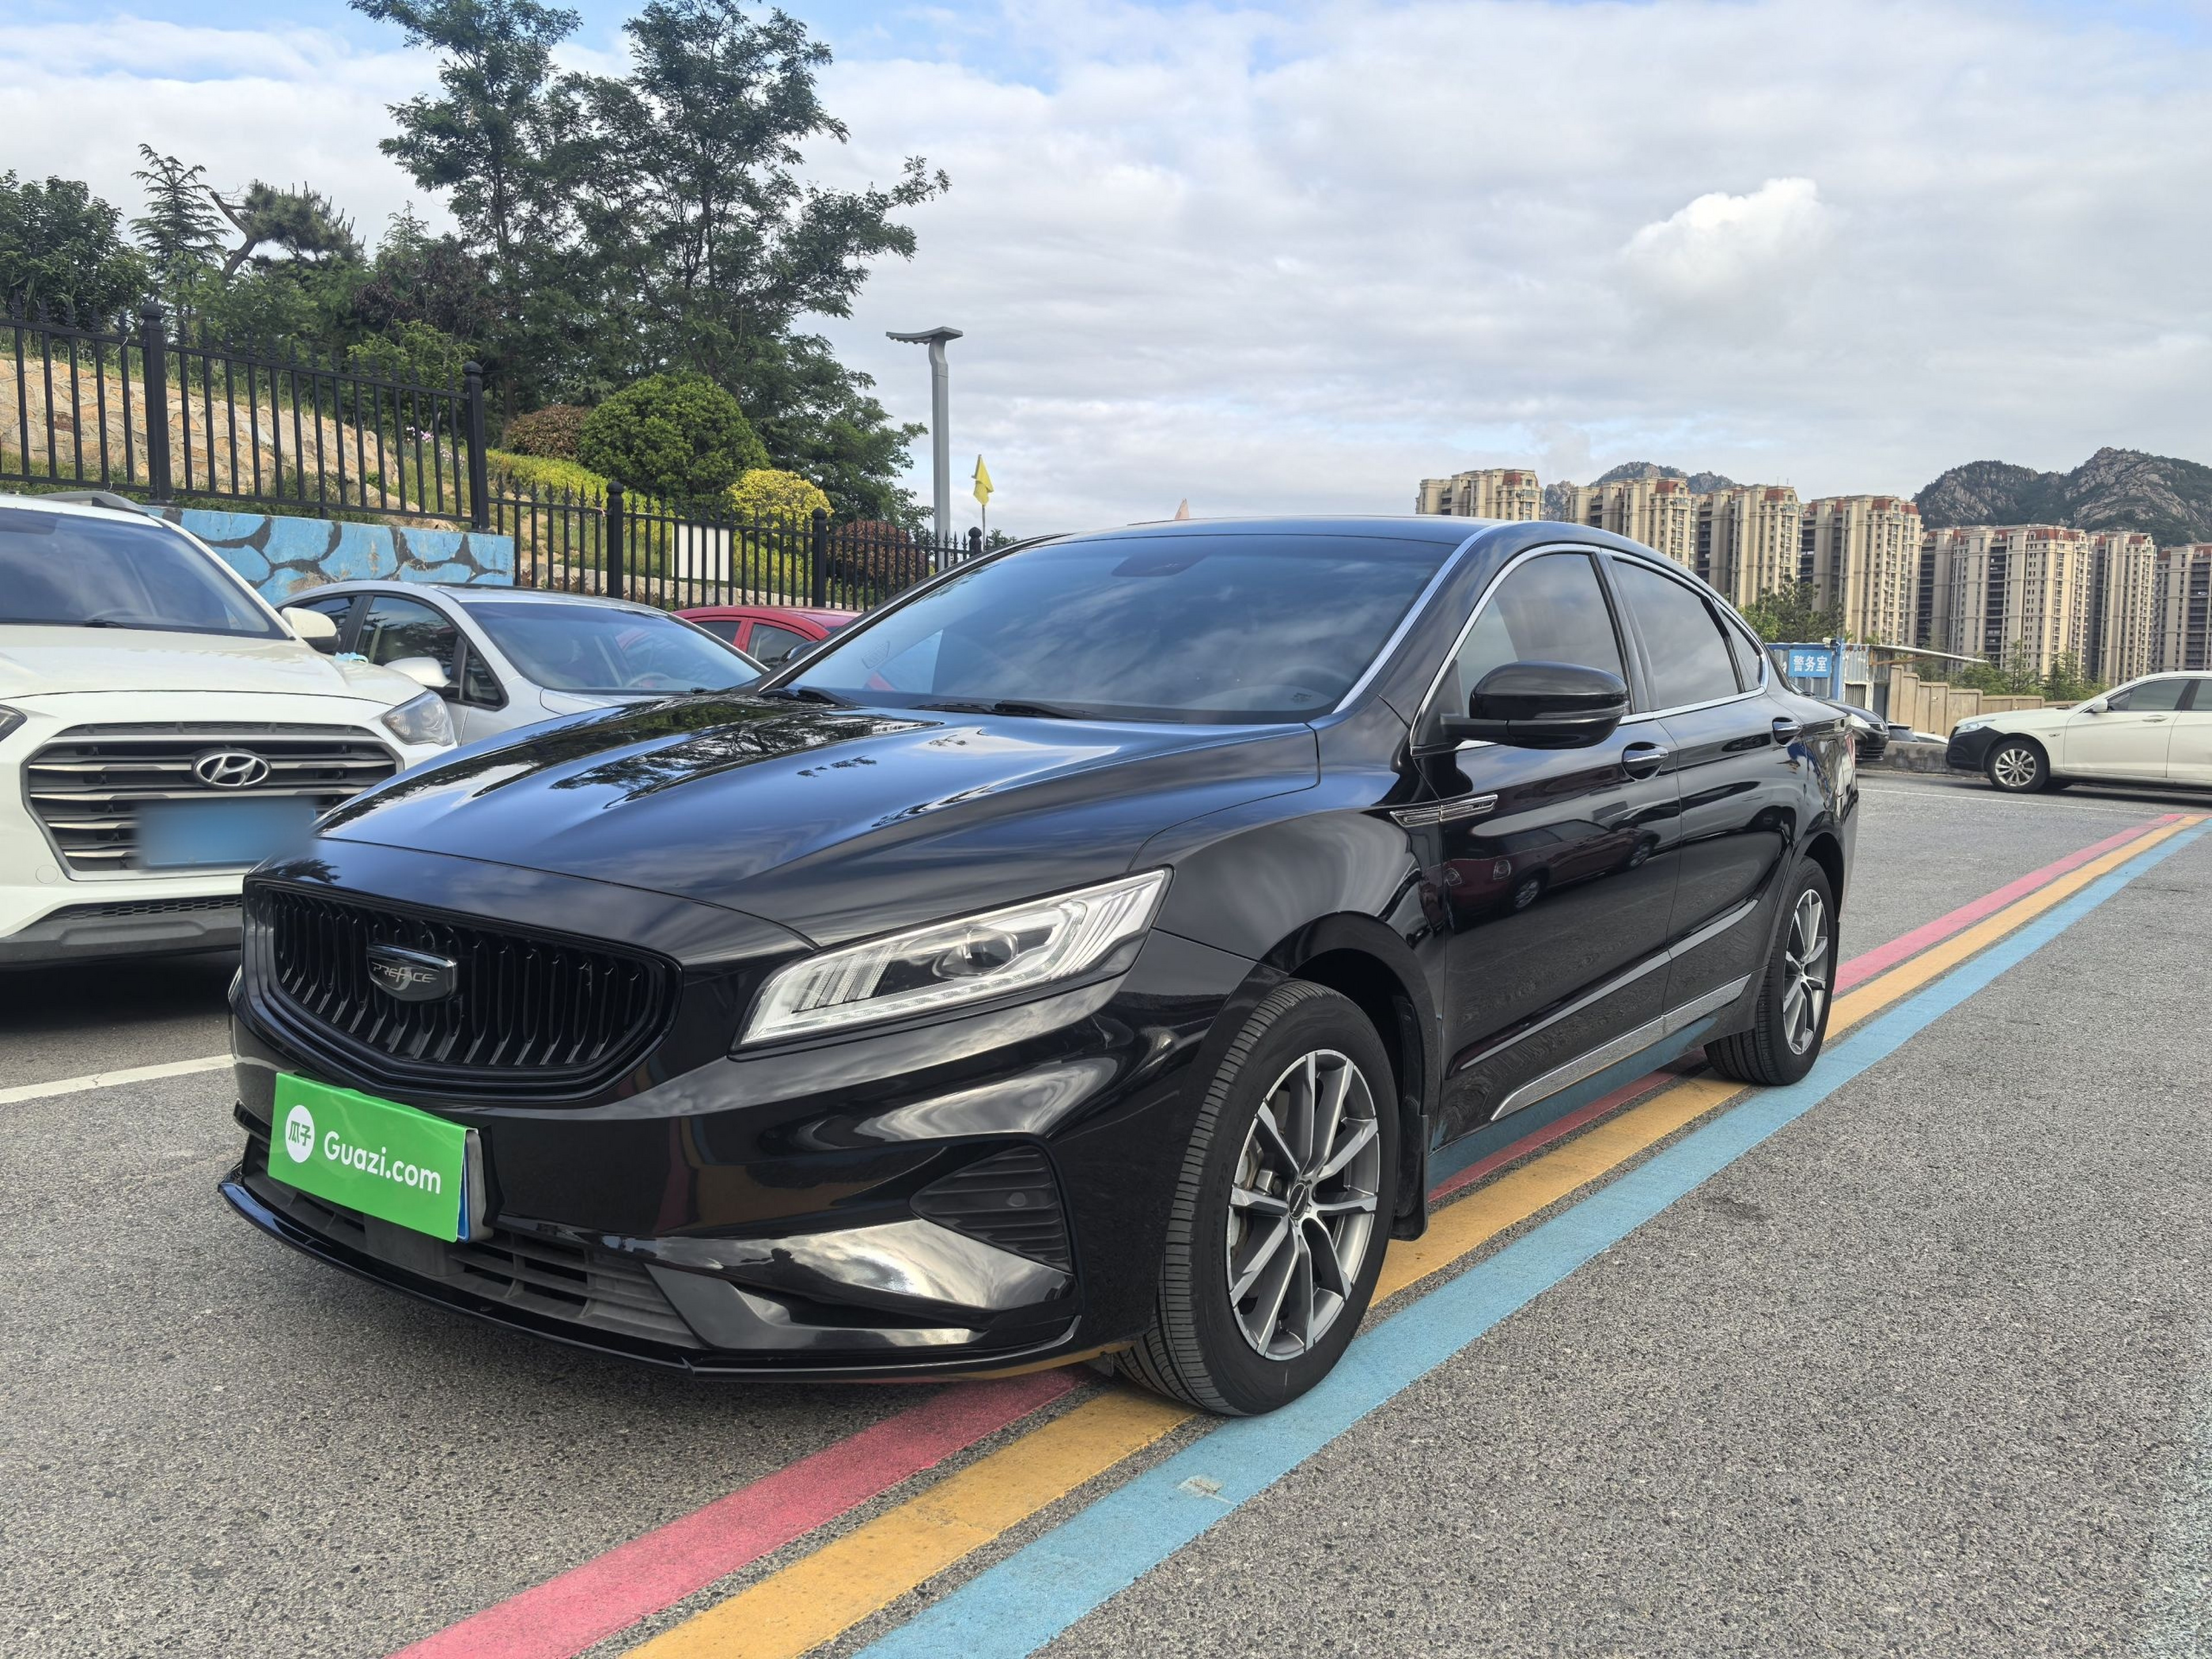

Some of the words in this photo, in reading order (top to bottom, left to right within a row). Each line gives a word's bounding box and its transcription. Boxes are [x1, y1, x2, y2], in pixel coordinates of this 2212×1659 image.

[1793, 656, 1827, 672] 警务室
[288, 1120, 311, 1146] 瓜子
[324, 1131, 441, 1194] Guazi.com
